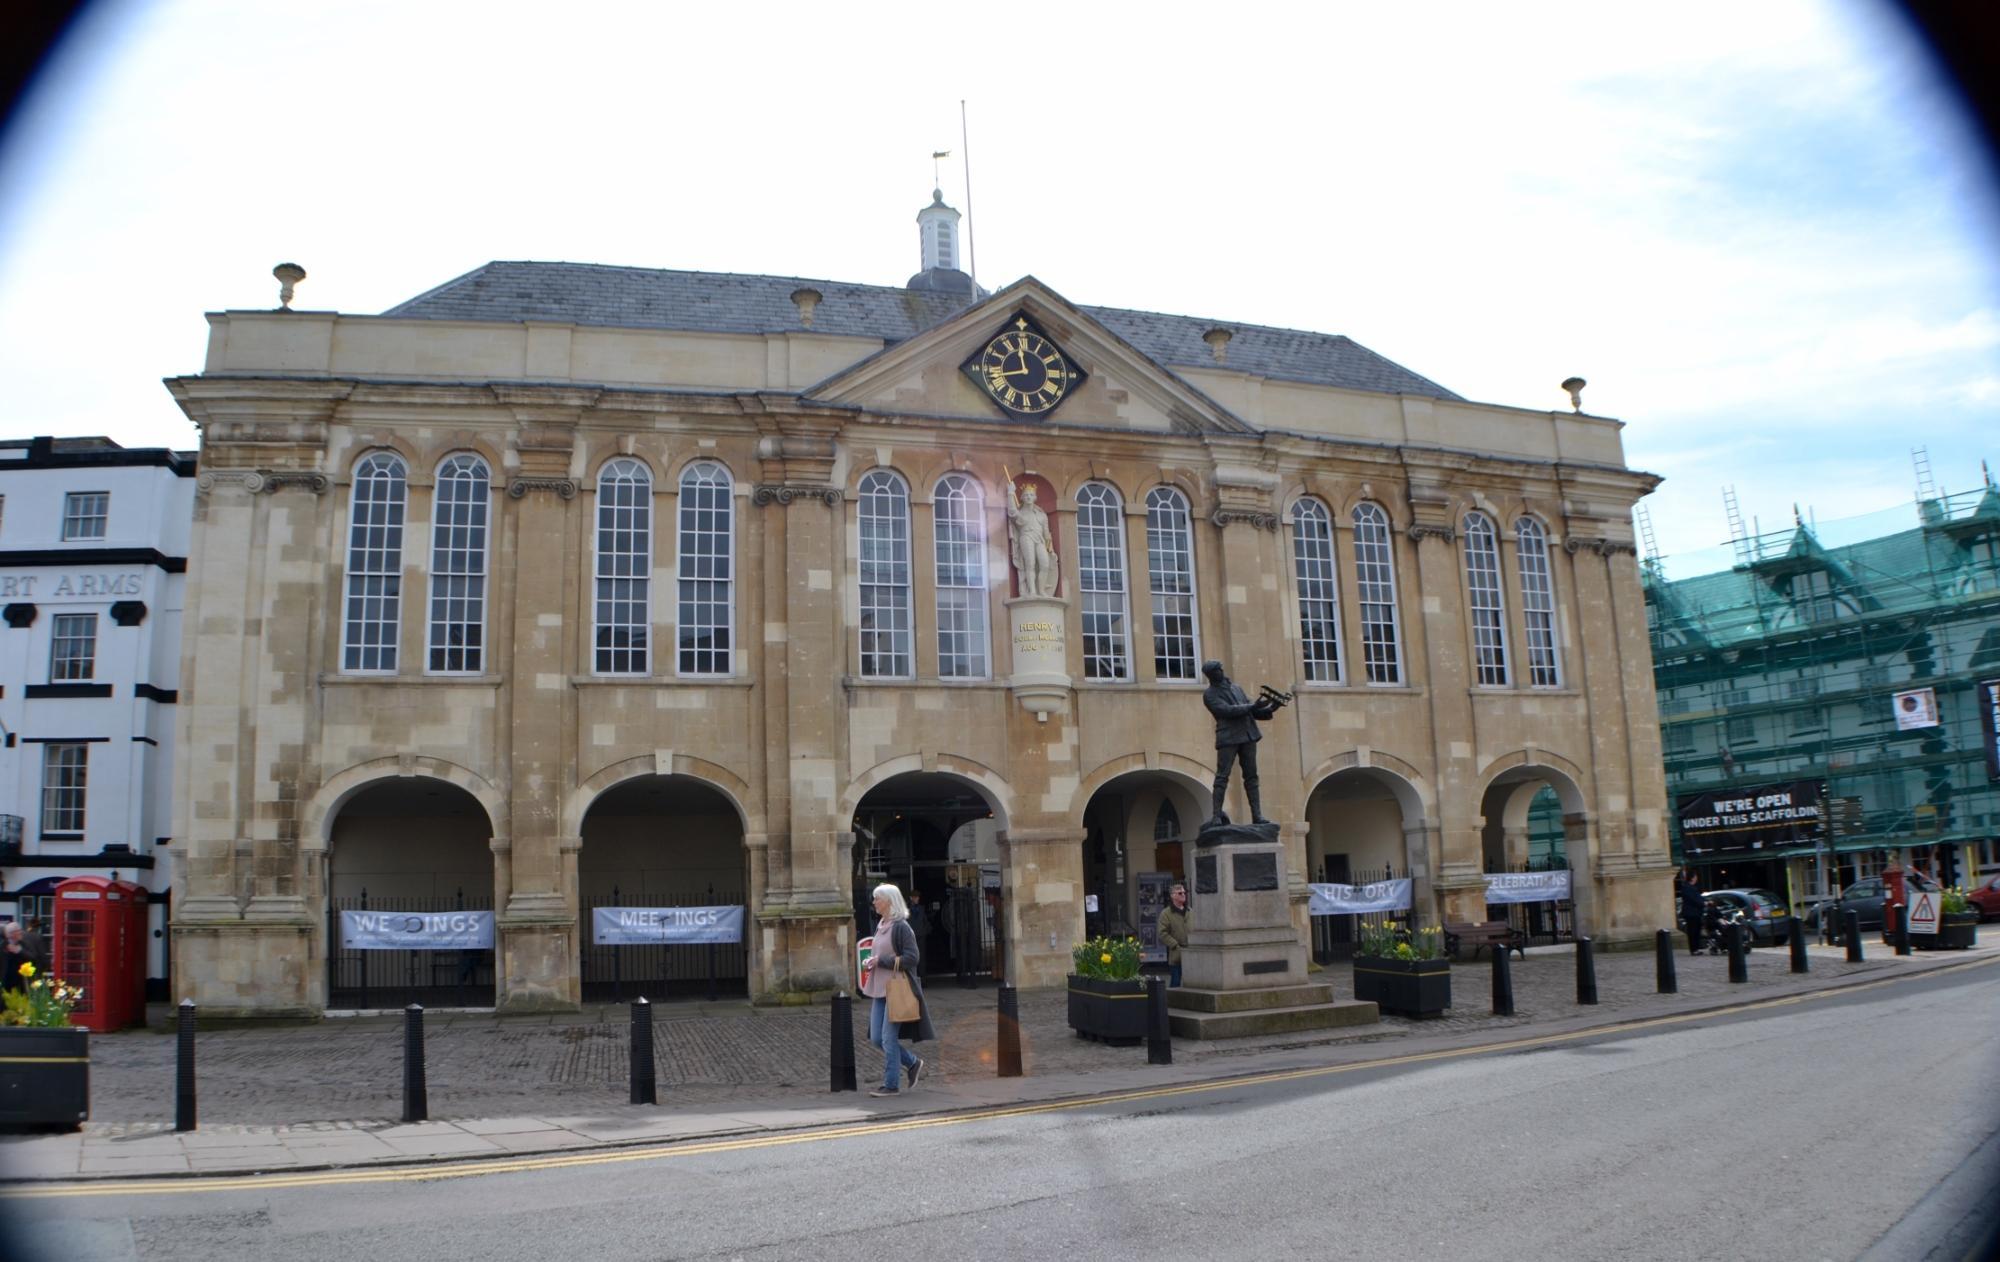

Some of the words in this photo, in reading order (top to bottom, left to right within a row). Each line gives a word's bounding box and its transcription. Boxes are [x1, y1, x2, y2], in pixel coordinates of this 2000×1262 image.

[1, 576, 38, 597] RT
[53, 574, 142, 596] ARMS
[1019, 623, 1054, 632] HENRY
[1713, 798, 1754, 813] WE'RE
[1756, 793, 1791, 808] OPEN
[1683, 816, 1720, 828] UNDER
[1722, 814, 1748, 825] THIS
[1751, 806, 1820, 822] SCAFFOLDIN
[1485, 873, 1567, 889] ELEBRATINS
[1324, 883, 1395, 900] HISORY
